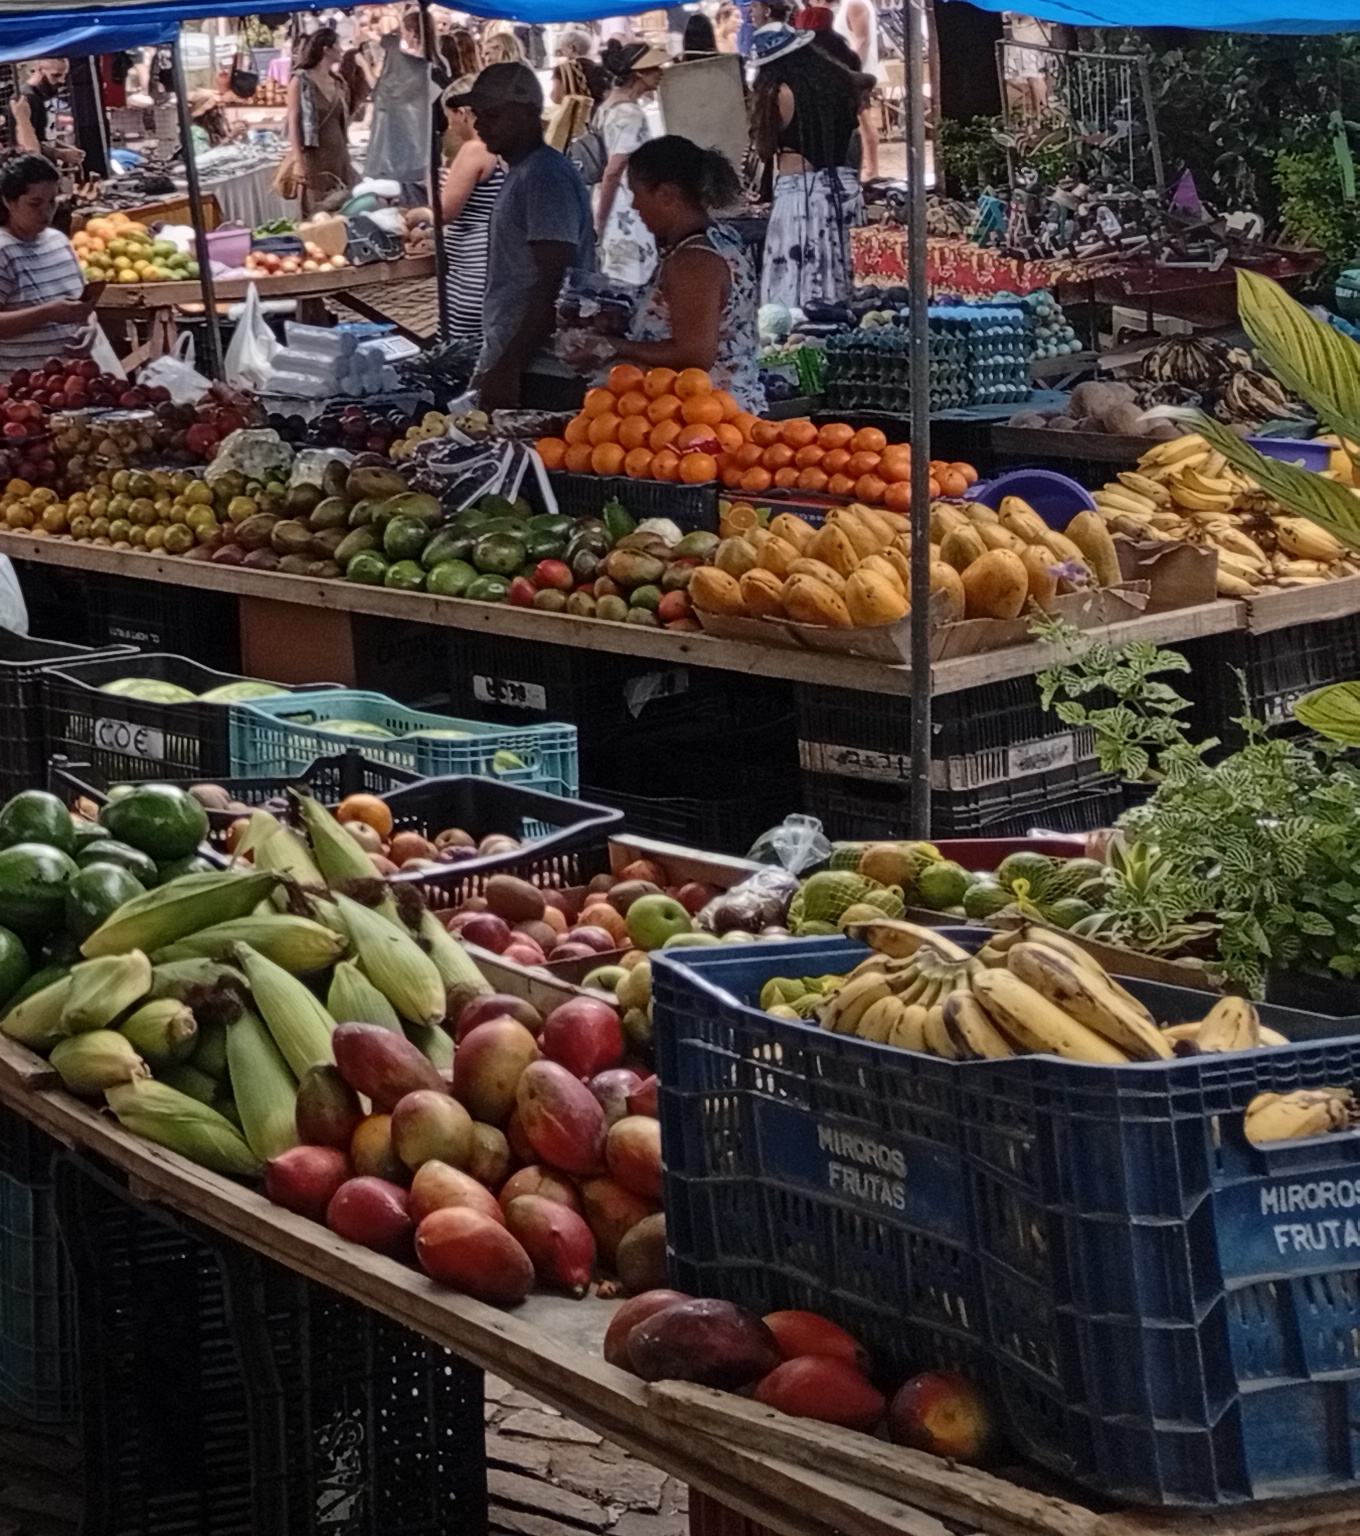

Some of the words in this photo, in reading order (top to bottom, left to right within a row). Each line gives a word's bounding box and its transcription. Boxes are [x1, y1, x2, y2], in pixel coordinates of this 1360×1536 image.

[817, 1123, 908, 1179] MIROROS
[828, 1161, 907, 1211] FRUTAS
[1273, 1218, 1360, 1255] FRUTA
